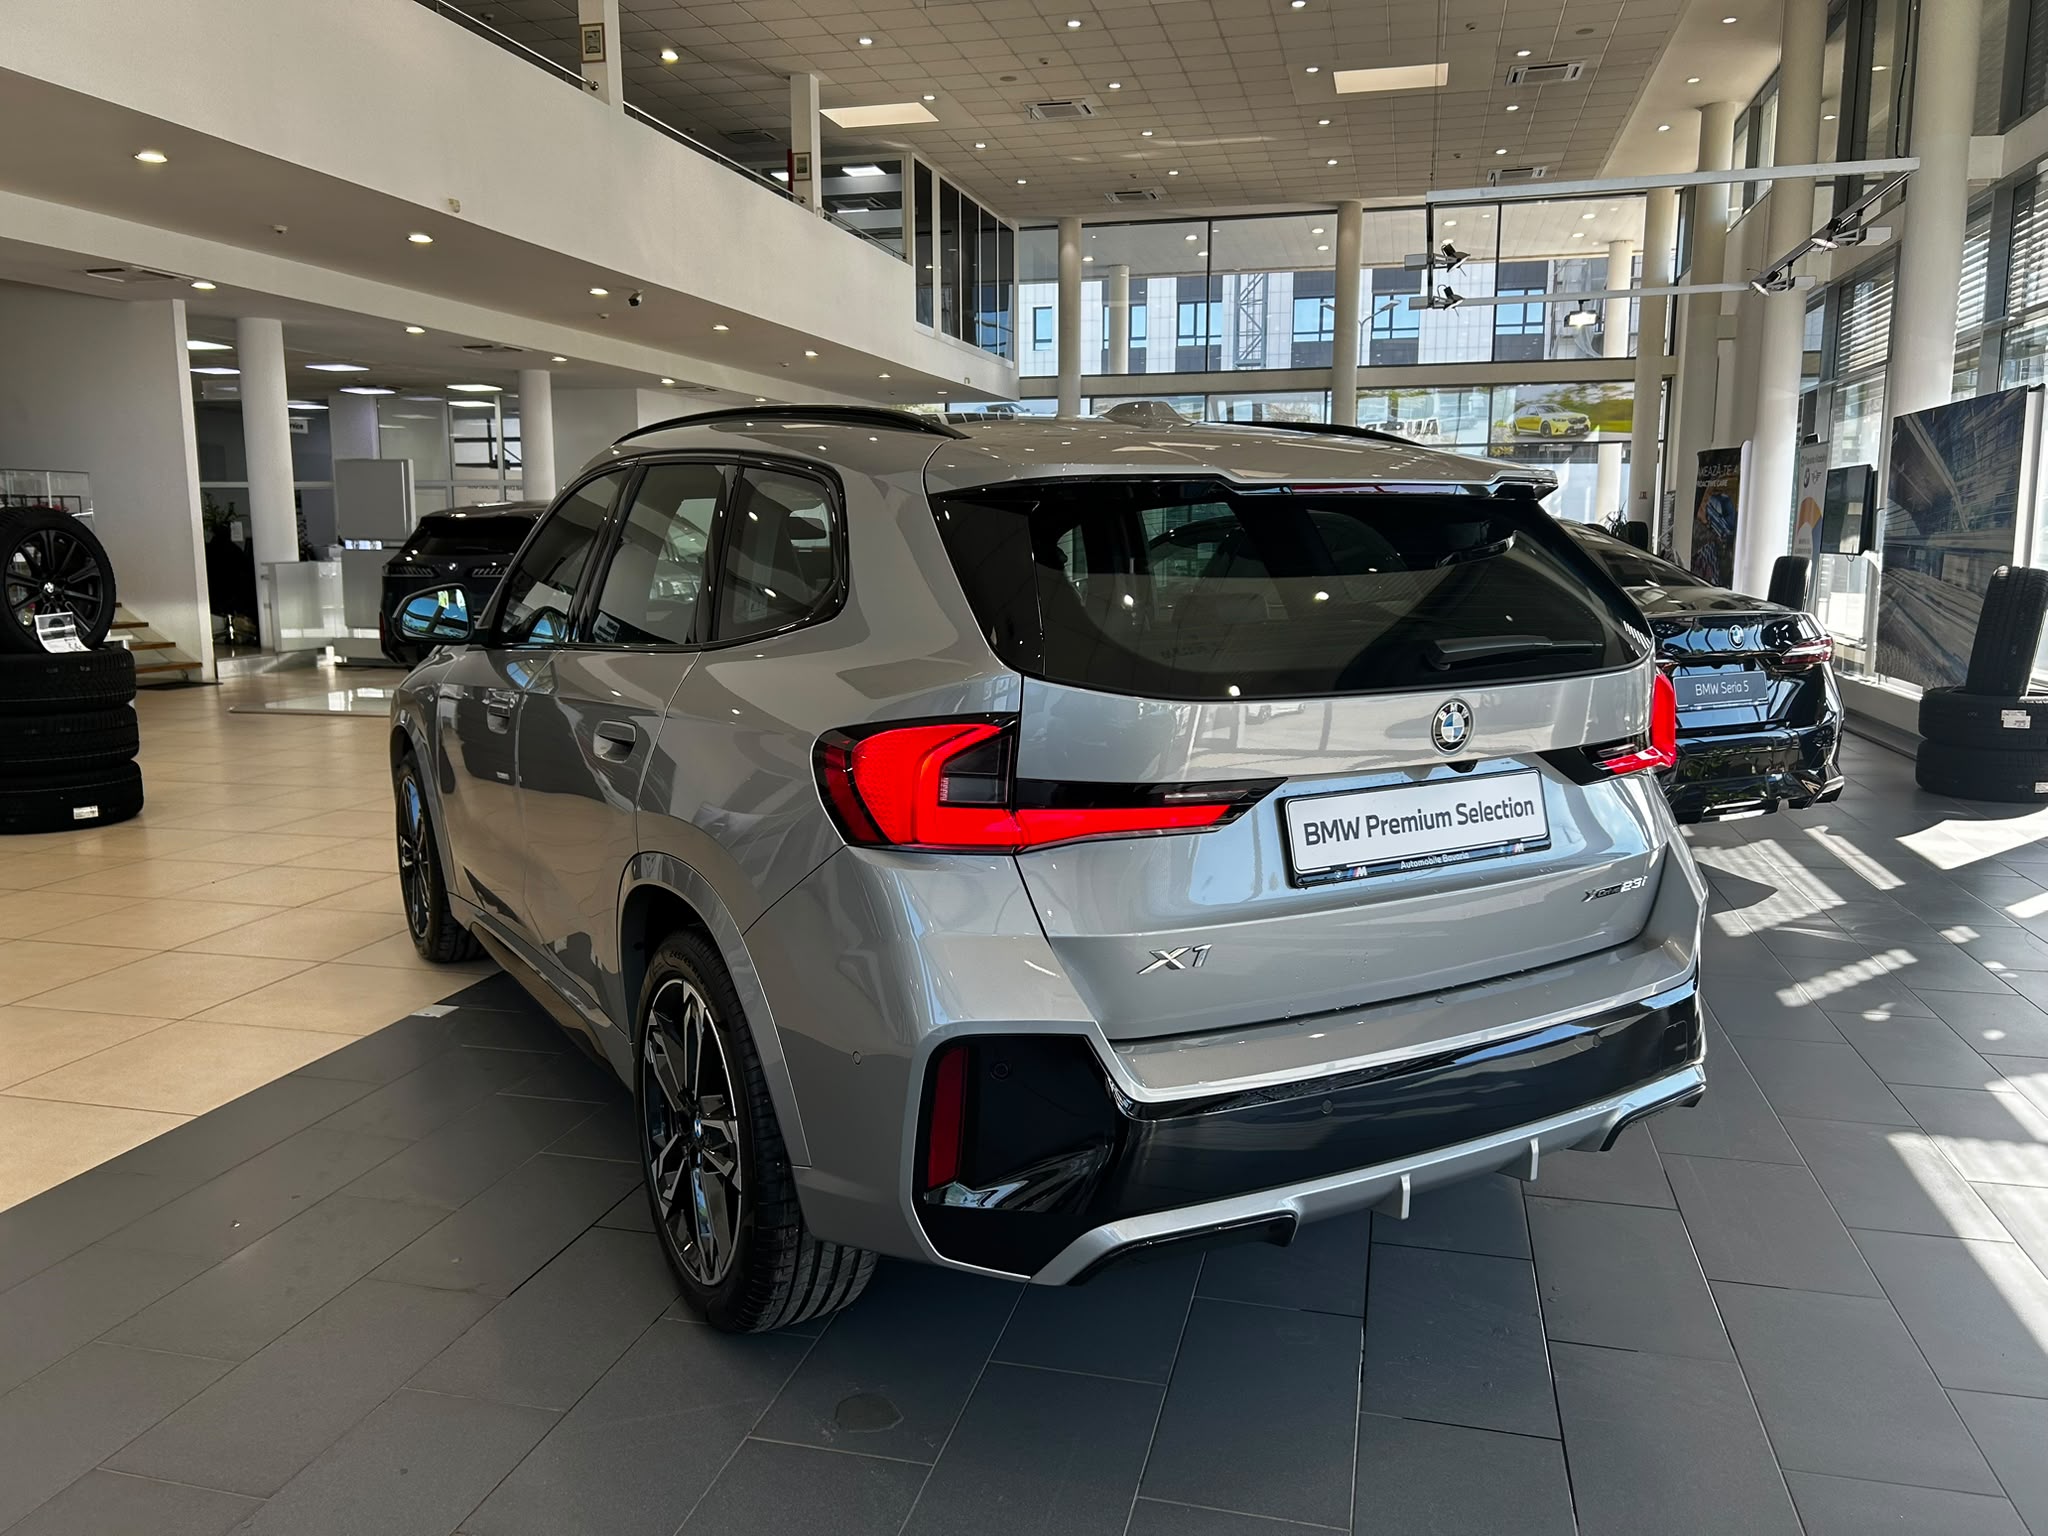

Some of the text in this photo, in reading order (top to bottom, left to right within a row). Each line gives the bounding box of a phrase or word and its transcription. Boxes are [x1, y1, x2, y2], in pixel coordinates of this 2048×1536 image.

[1695, 680, 1749, 696] BMW Seria 5
[1303, 797, 1535, 846] BMW Premium Selection
[1400, 851, 1470, 870] Automobile Bavaria
[1136, 943, 1213, 974] X1
